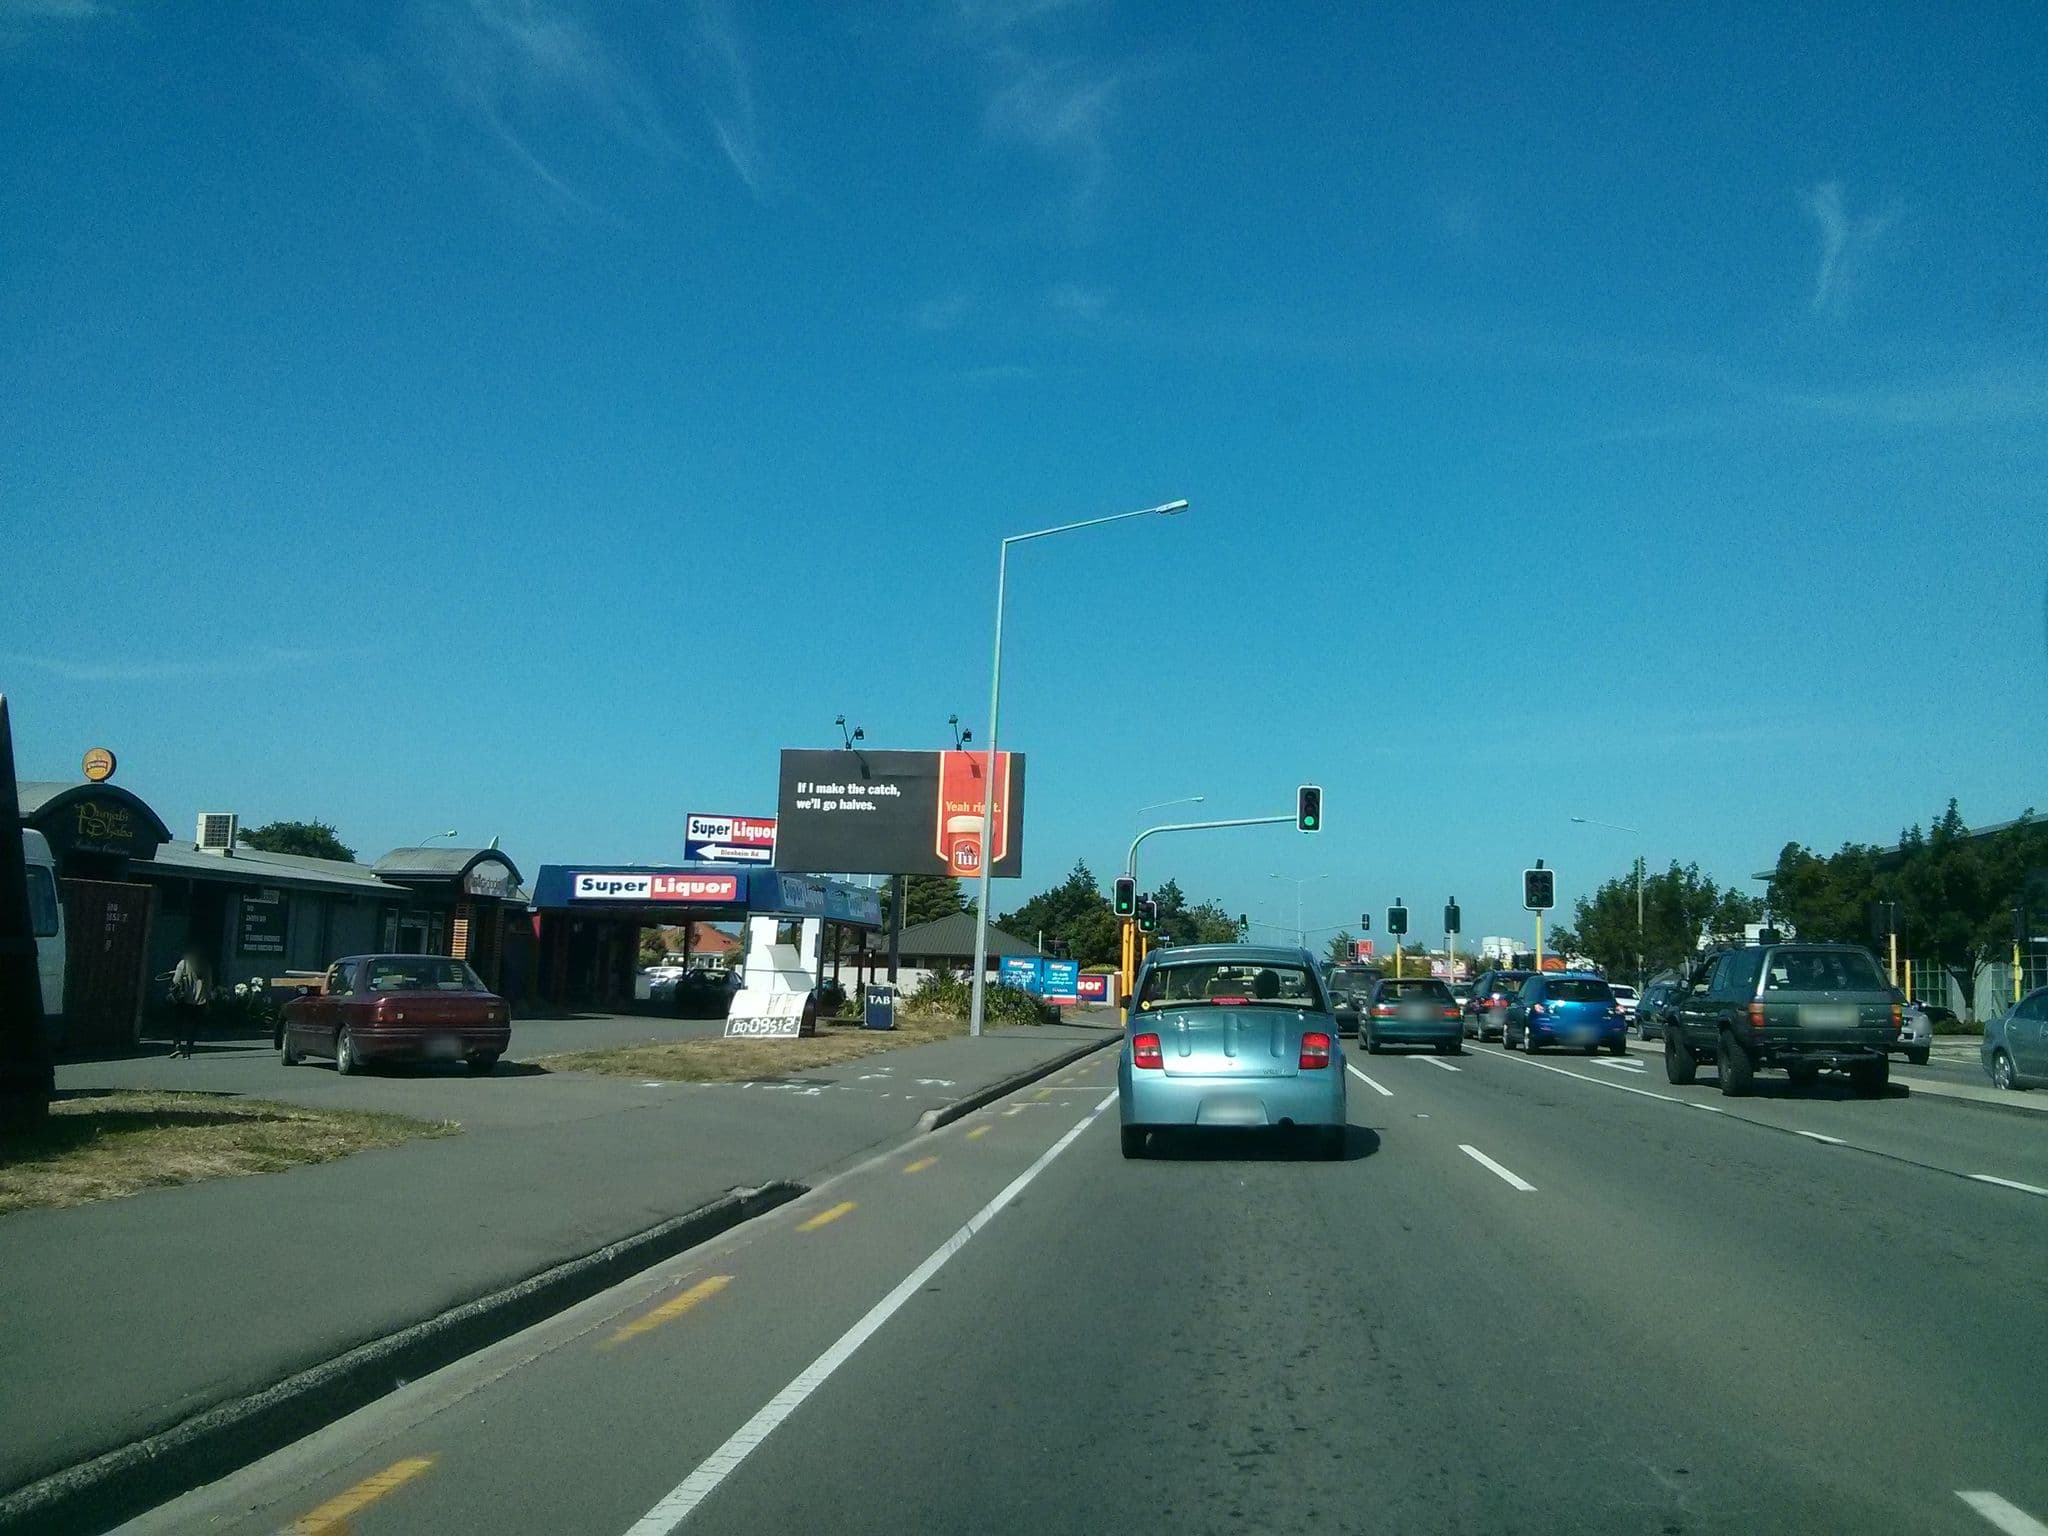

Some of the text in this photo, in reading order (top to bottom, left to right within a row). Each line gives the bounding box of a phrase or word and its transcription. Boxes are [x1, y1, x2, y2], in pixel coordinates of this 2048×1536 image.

[797, 781, 901, 797] If I make the catch,
[796, 797, 877, 812] we'll go halves.
[946, 800, 1001, 815] Yeah rigt.
[691, 819, 731, 839] Super
[955, 851, 978, 866] Tui
[581, 877, 733, 897] Super Liquor
[869, 995, 891, 1005] TAB
